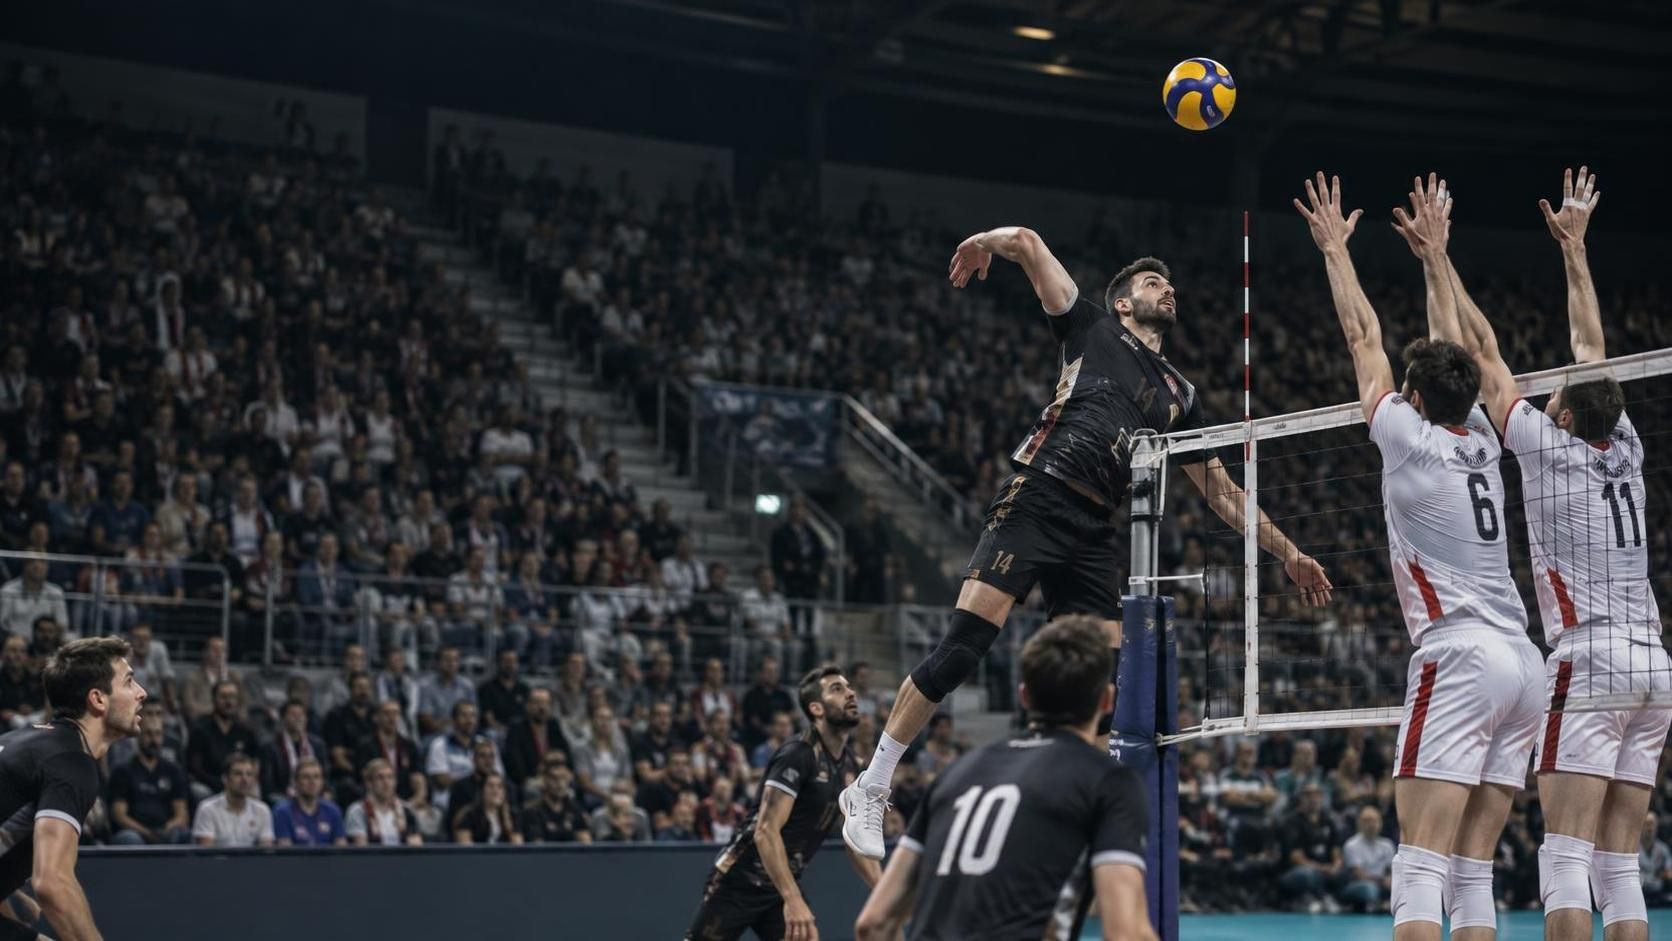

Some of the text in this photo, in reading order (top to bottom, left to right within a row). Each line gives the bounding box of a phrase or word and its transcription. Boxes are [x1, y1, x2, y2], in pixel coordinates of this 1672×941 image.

[1467, 473, 1499, 541] 6
[1602, 482, 1642, 548] 11
[990, 550, 1015, 575] 14
[936, 784, 1021, 876] 10
